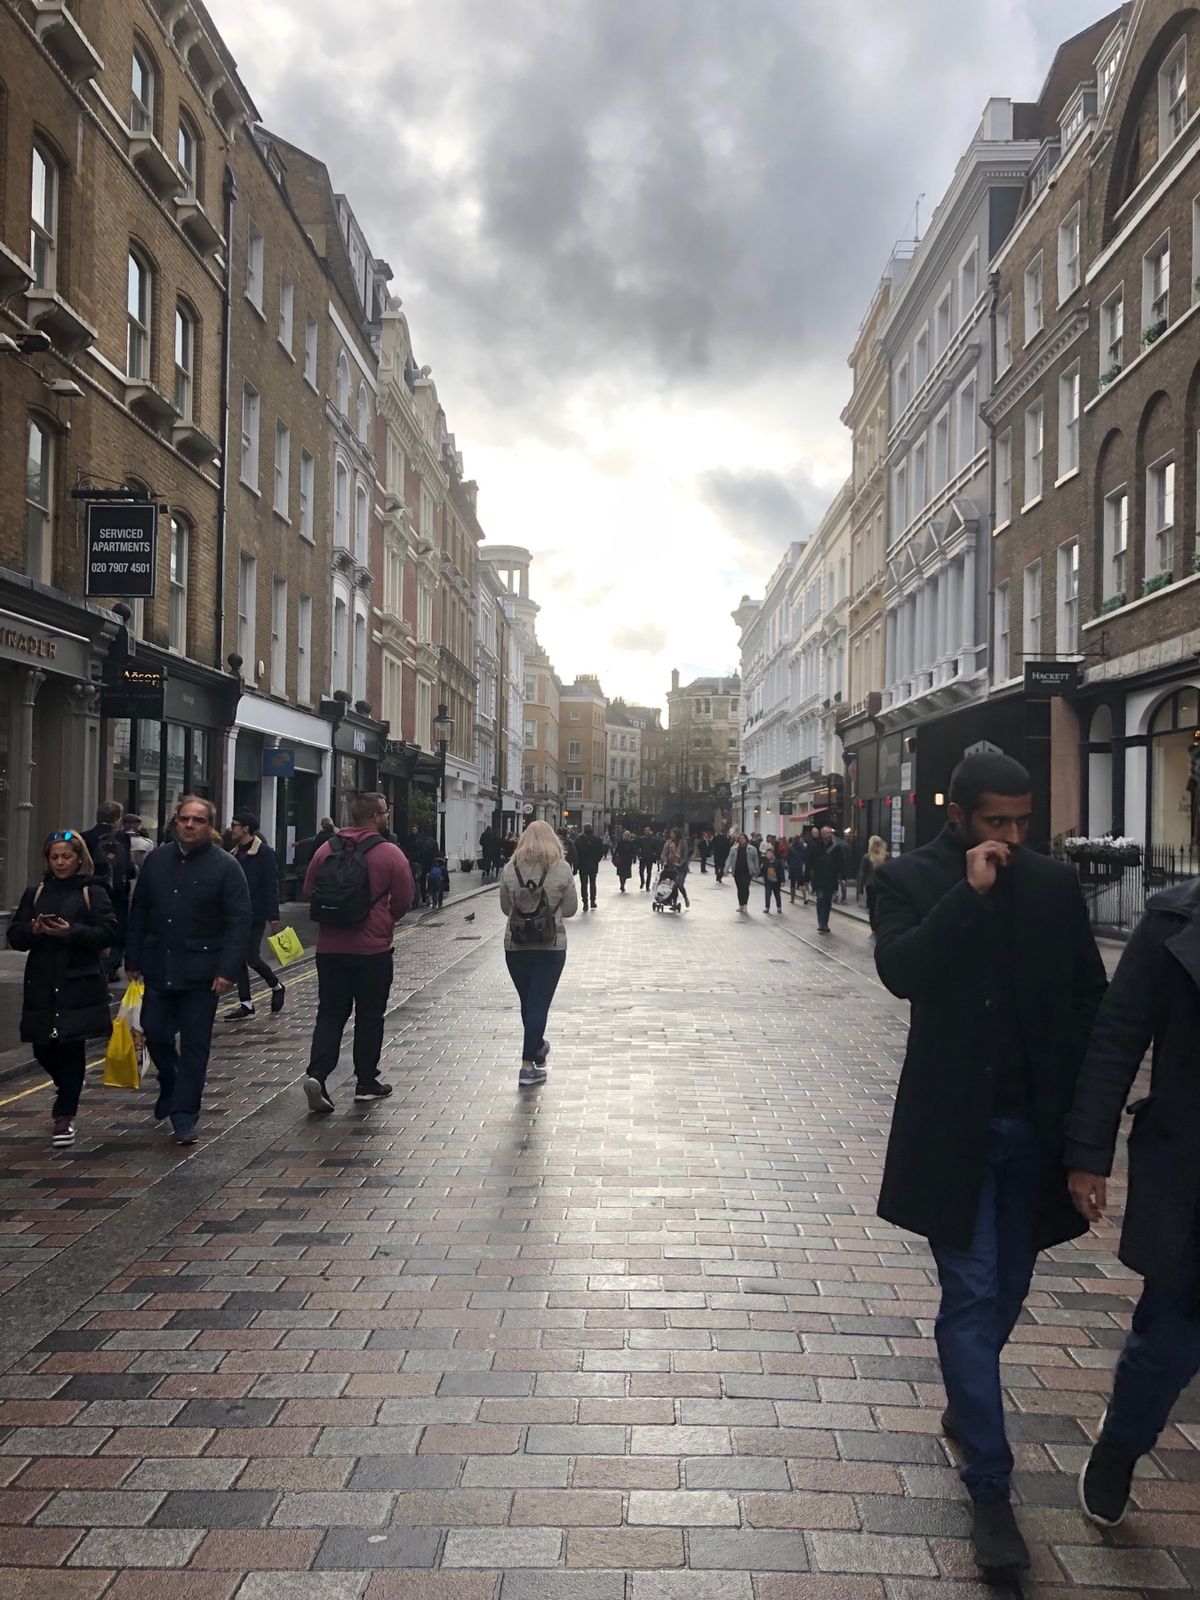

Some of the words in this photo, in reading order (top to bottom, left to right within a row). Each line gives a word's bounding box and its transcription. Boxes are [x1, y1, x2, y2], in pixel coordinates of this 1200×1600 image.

[99, 528, 144, 539] SERVICED
[92, 541, 151, 552] APARTMENTS
[91, 562, 107, 573] 020
[108, 562, 129, 573] 7907
[130, 562, 150, 573] 4501
[1031, 672, 1069, 680] HACKETT
